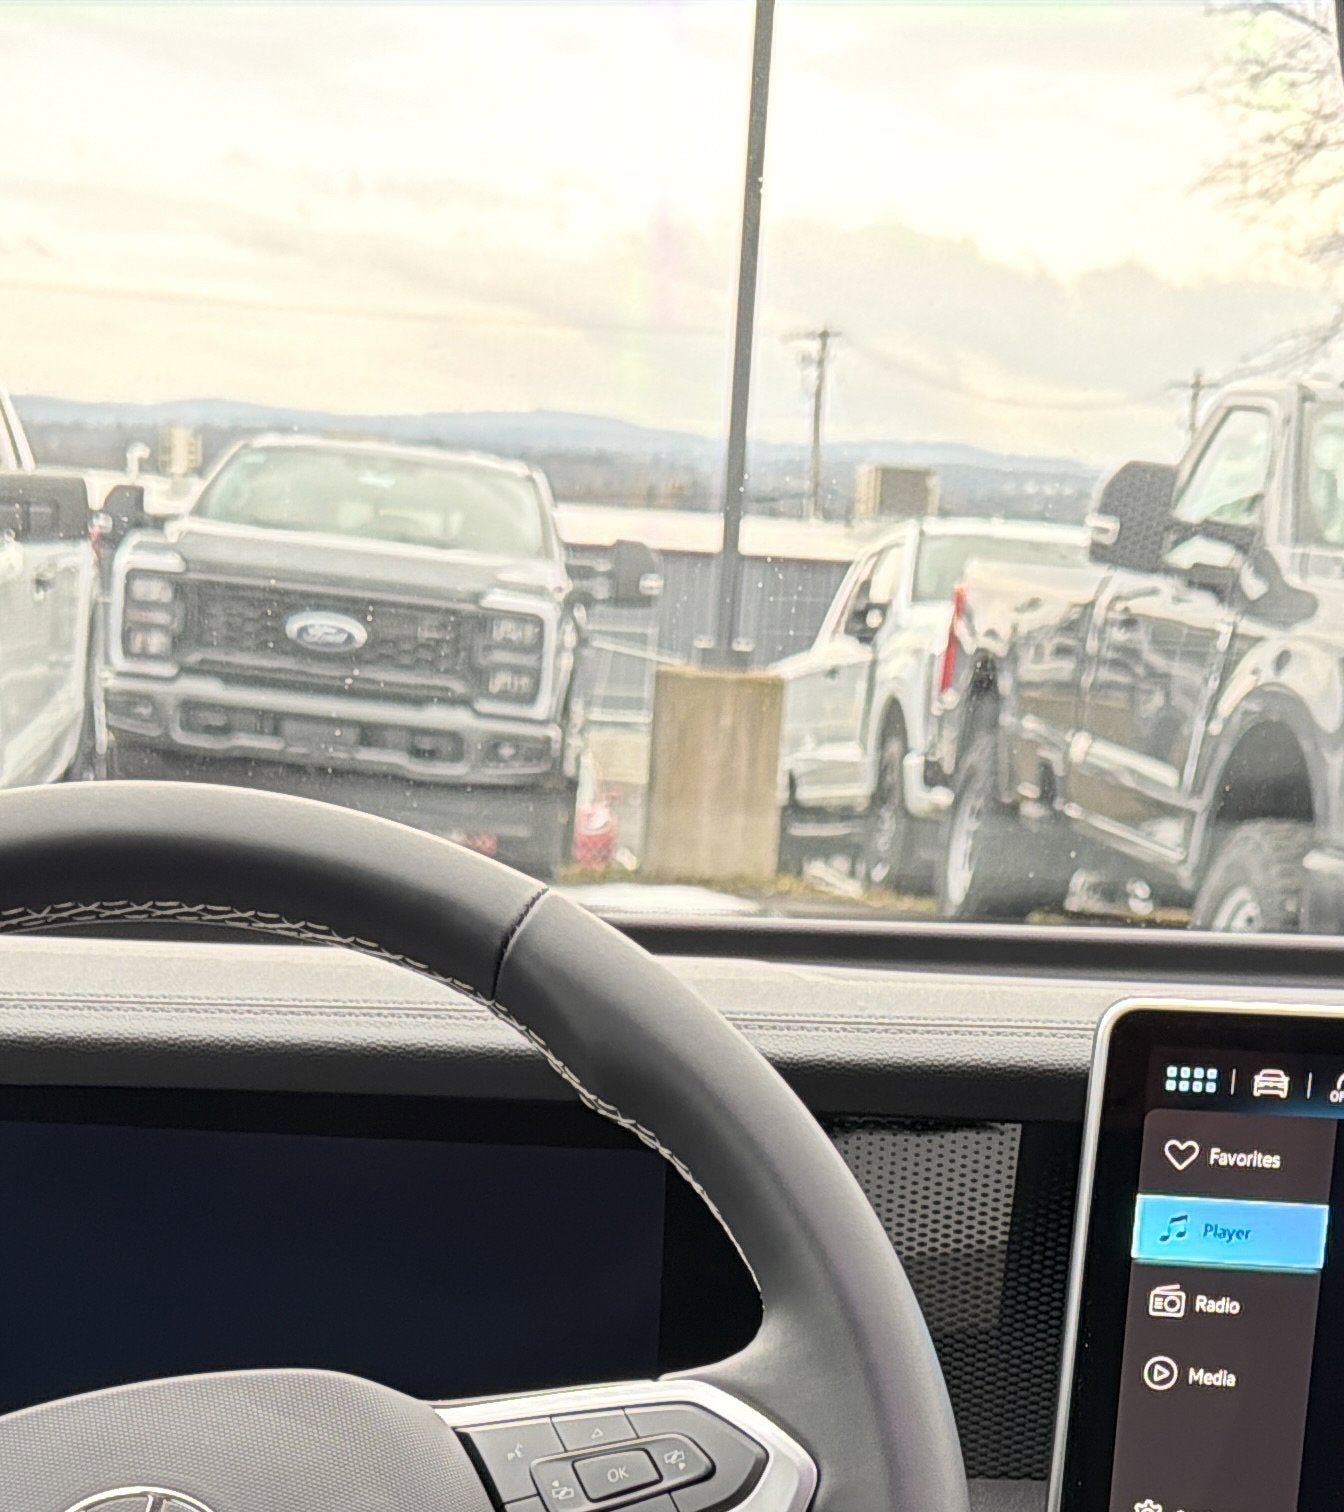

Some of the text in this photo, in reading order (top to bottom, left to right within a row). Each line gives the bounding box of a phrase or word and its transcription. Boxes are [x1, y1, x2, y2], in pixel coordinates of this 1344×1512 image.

[1209, 1147, 1281, 1169] Favorites
[1203, 1223, 1252, 1243] Player
[1195, 1294, 1241, 1315] Radio
[1188, 1367, 1237, 1387] Media
[606, 1466, 630, 1484] OK
